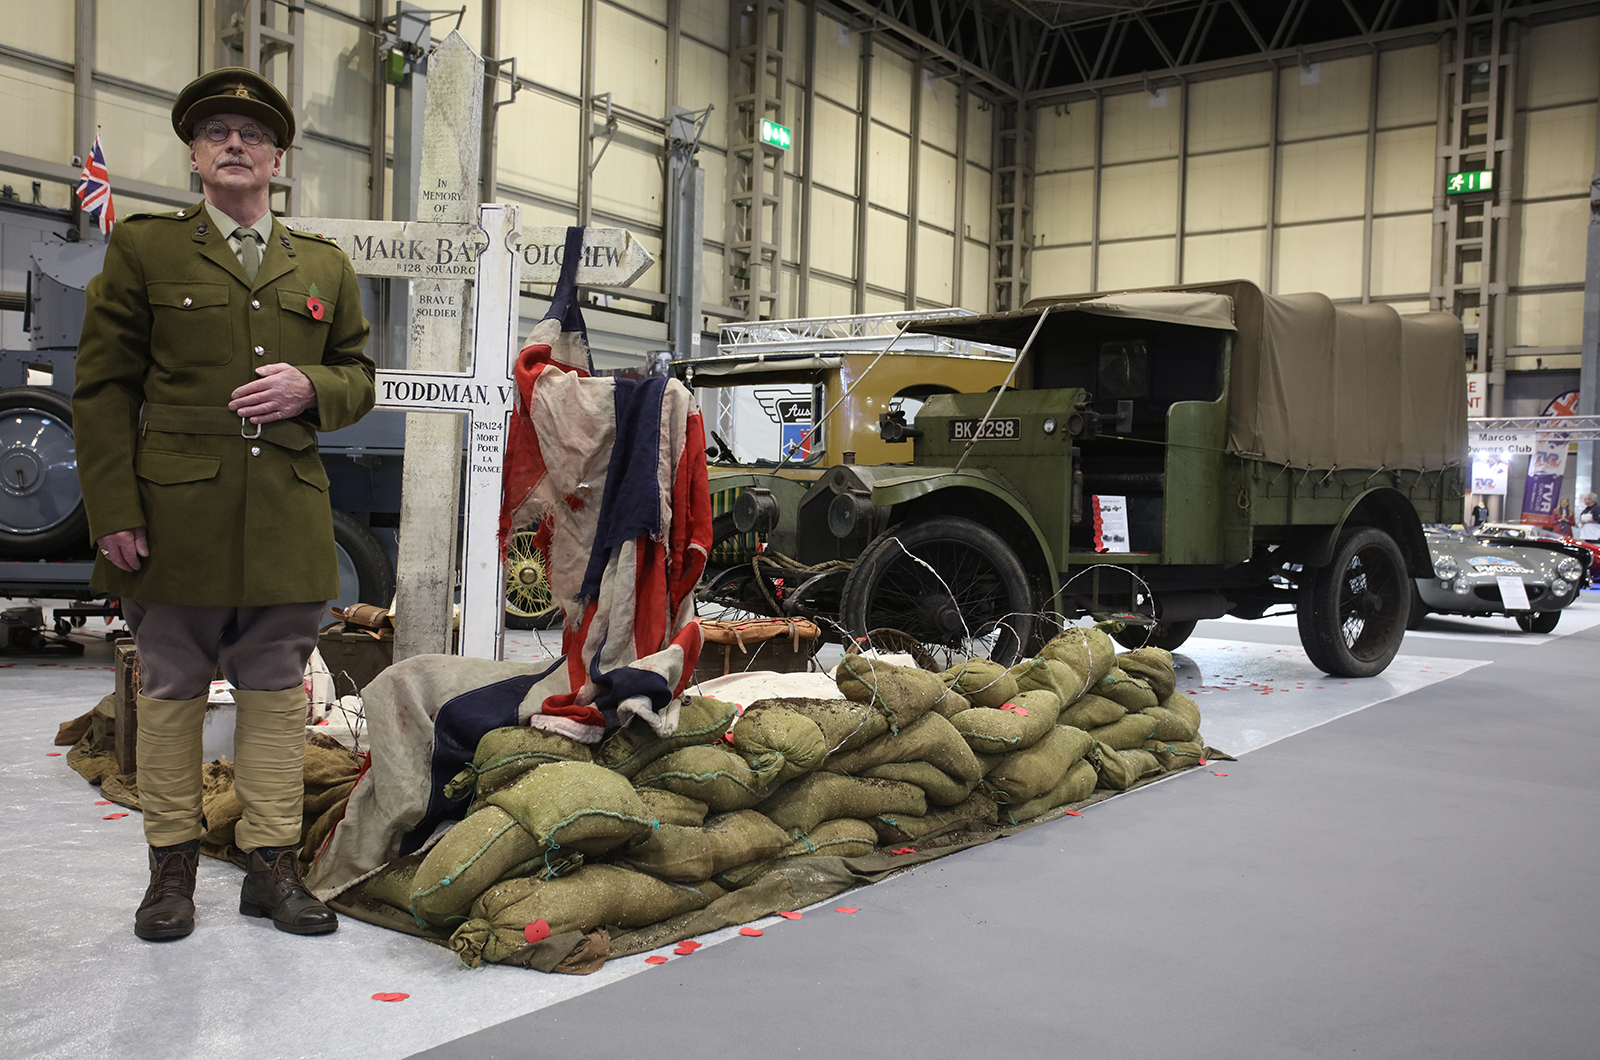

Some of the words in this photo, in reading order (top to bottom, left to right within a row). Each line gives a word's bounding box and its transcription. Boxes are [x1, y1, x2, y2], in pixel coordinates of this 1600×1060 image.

[437, 178, 447, 188] IN
[422, 190, 463, 201] MEMORY
[433, 204, 448, 213] OF
[352, 234, 426, 261] MARK
[433, 283, 441, 292] A
[419, 295, 455, 305] BRAVE
[417, 308, 457, 318] SOLDIER
[383, 381, 490, 406] TODDMAN,
[955, 421, 972, 438] BK
[976, 420, 1014, 438] 3298
[476, 433, 499, 442] MORT
[1479, 433, 1518, 442] Marcos
[477, 444, 499, 453] POUR
[1508, 445, 1532, 453] Club
[473, 465, 501, 474] FRANCE
[1540, 482, 1554, 513] TVR
